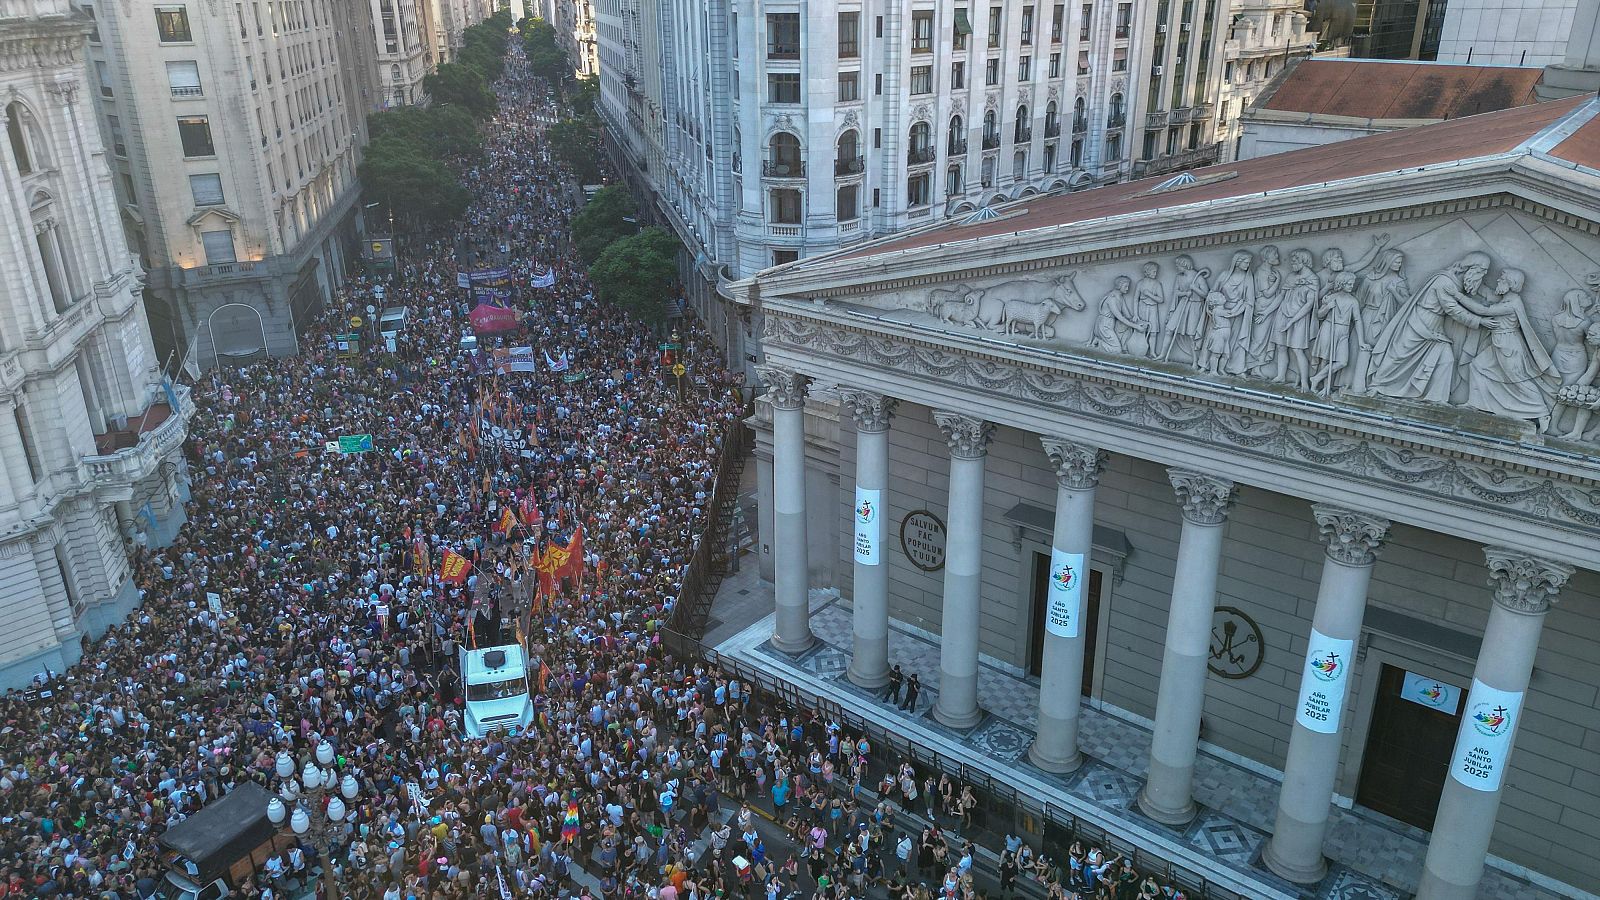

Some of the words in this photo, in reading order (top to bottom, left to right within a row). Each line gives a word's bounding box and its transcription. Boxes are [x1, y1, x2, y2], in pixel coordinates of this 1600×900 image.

[910, 518, 939, 533] SALVUM
[918, 530, 932, 542] FAC
[856, 546, 870, 556] 2025
[908, 538, 942, 556] POPULUM
[913, 550, 936, 564] TUUM
[1052, 606, 1068, 614] SANTO
[1050, 616, 1068, 626] 2025
[1308, 696, 1328, 706] SANTO
[1312, 691, 1326, 700] AÑO
[1305, 702, 1330, 713] JUBILAR
[1305, 708, 1328, 721] 2025
[1473, 746, 1489, 756] AÑO
[1468, 752, 1492, 763] SANTO
[1464, 757, 1493, 770] JUBILAR
[1464, 764, 1490, 778] 2025
